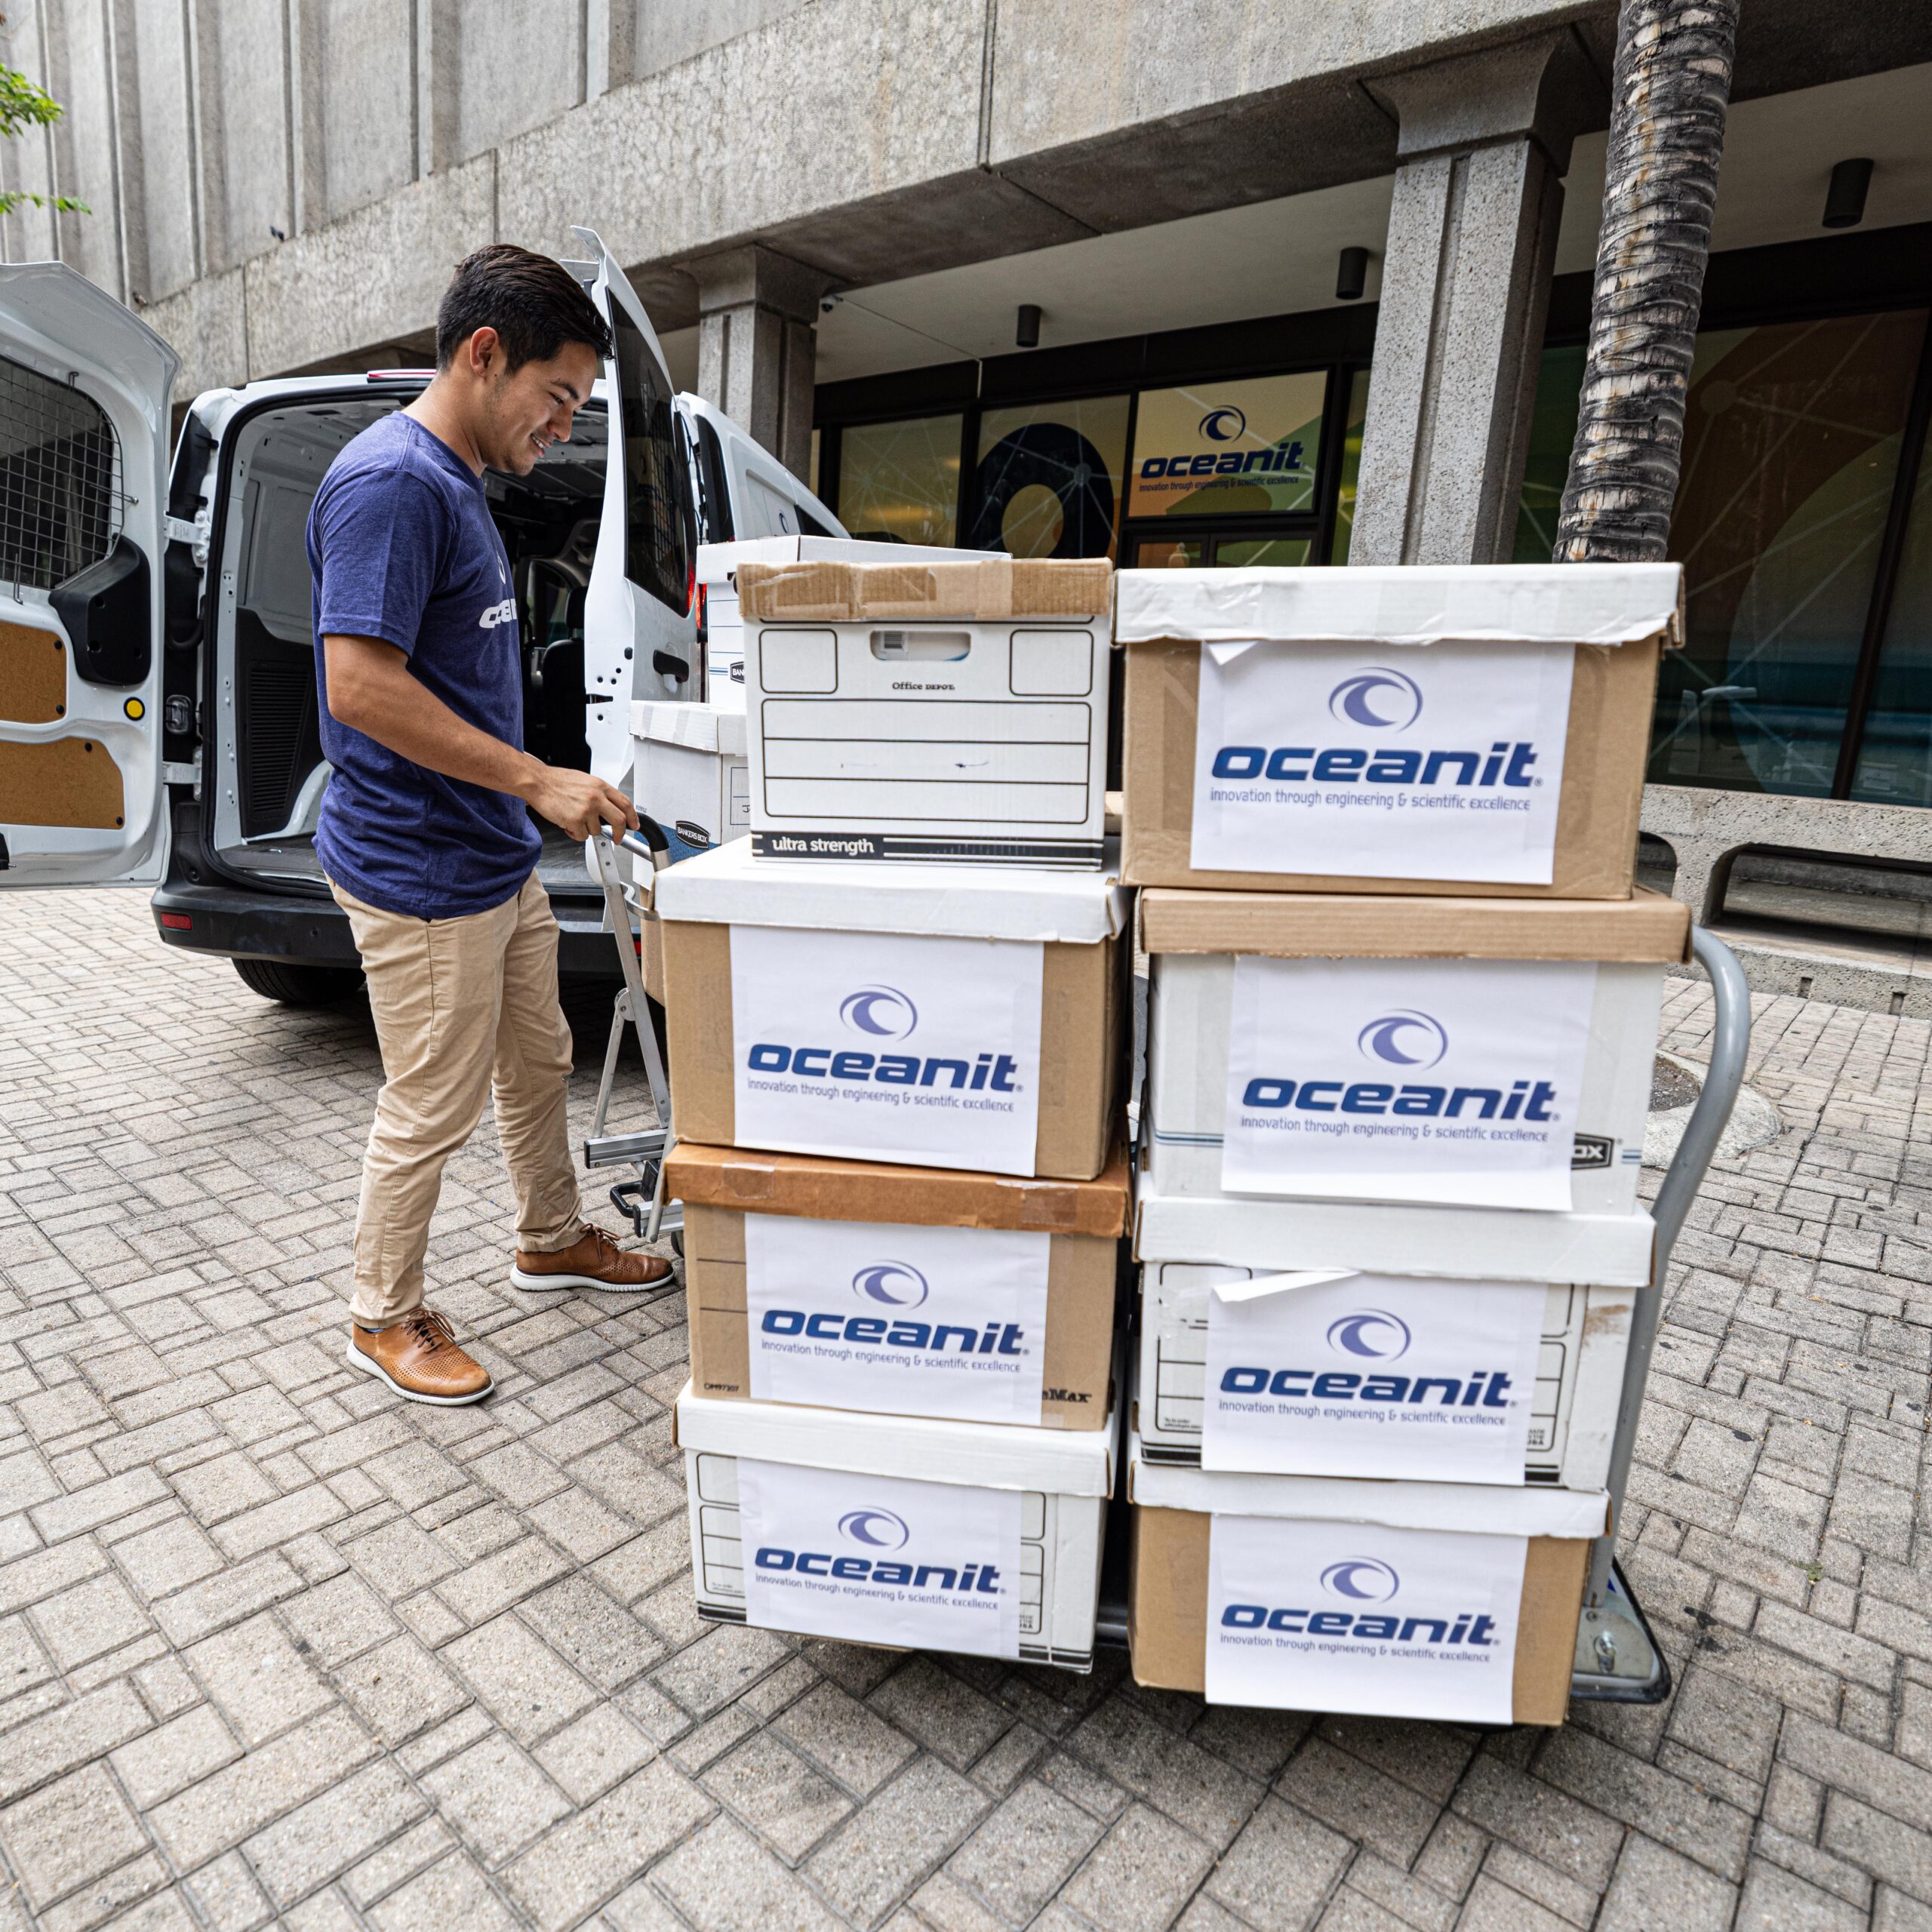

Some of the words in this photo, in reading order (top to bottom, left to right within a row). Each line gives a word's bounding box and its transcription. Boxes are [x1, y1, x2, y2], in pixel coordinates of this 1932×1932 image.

[1141, 441, 1303, 478] oceanit
[1140, 483, 1169, 491] innovation
[1171, 481, 1193, 491] through
[1195, 479, 1229, 489] engineering
[1238, 477, 1265, 486] scientific
[1267, 475, 1299, 485] excellence
[893, 681, 922, 690] Office
[1211, 787, 1271, 802] innovation
[1276, 789, 1321, 808] through
[1326, 793, 1393, 809] engineering
[1398, 795, 1407, 807] &
[1412, 795, 1466, 808] scientific
[1470, 796, 1531, 811] excellence
[677, 826, 697, 840] BANKERS
[697, 833, 707, 844] BOX
[772, 836, 808, 852] ultra
[811, 838, 875, 856] strength
[748, 1078, 798, 1094] innovation
[801, 1083, 839, 1097] through
[843, 1088, 899, 1105] engineering
[903, 1093, 911, 1103] &
[915, 1094, 959, 1108] scientific
[963, 1100, 1014, 1112] excellence
[1241, 1116, 1300, 1131] innovation
[1305, 1119, 1349, 1136] through
[1354, 1124, 1418, 1140] engineering
[1423, 1126, 1431, 1137] &
[1435, 1126, 1487, 1140] scientific
[1491, 1129, 1547, 1142] excellence
[762, 1339, 811, 1355] innovation
[814, 1345, 852, 1359] through
[856, 1351, 910, 1367] engineering
[914, 1355, 921, 1365] &
[925, 1357, 968, 1370] scientific
[972, 1361, 1020, 1373] excellence
[1219, 1400, 1275, 1414] innovation
[1278, 1404, 1320, 1418] through
[1324, 1408, 1384, 1423] engineering
[1389, 1411, 1397, 1421] &
[1401, 1411, 1447, 1423] scientific
[1452, 1415, 1505, 1426] excellence
[755, 1573, 801, 1588] innovation
[804, 1580, 840, 1593] through
[843, 1586, 894, 1601] engineering
[898, 1592, 905, 1600] &
[909, 1592, 949, 1606] scientific
[952, 1598, 998, 1610] excellence
[1220, 1633, 1272, 1646] innovation
[1276, 1638, 1315, 1651] through
[1319, 1642, 1376, 1657] engineering
[1380, 1645, 1387, 1655] &
[1391, 1646, 1436, 1659] scientific
[1440, 1651, 1490, 1662] excellence
